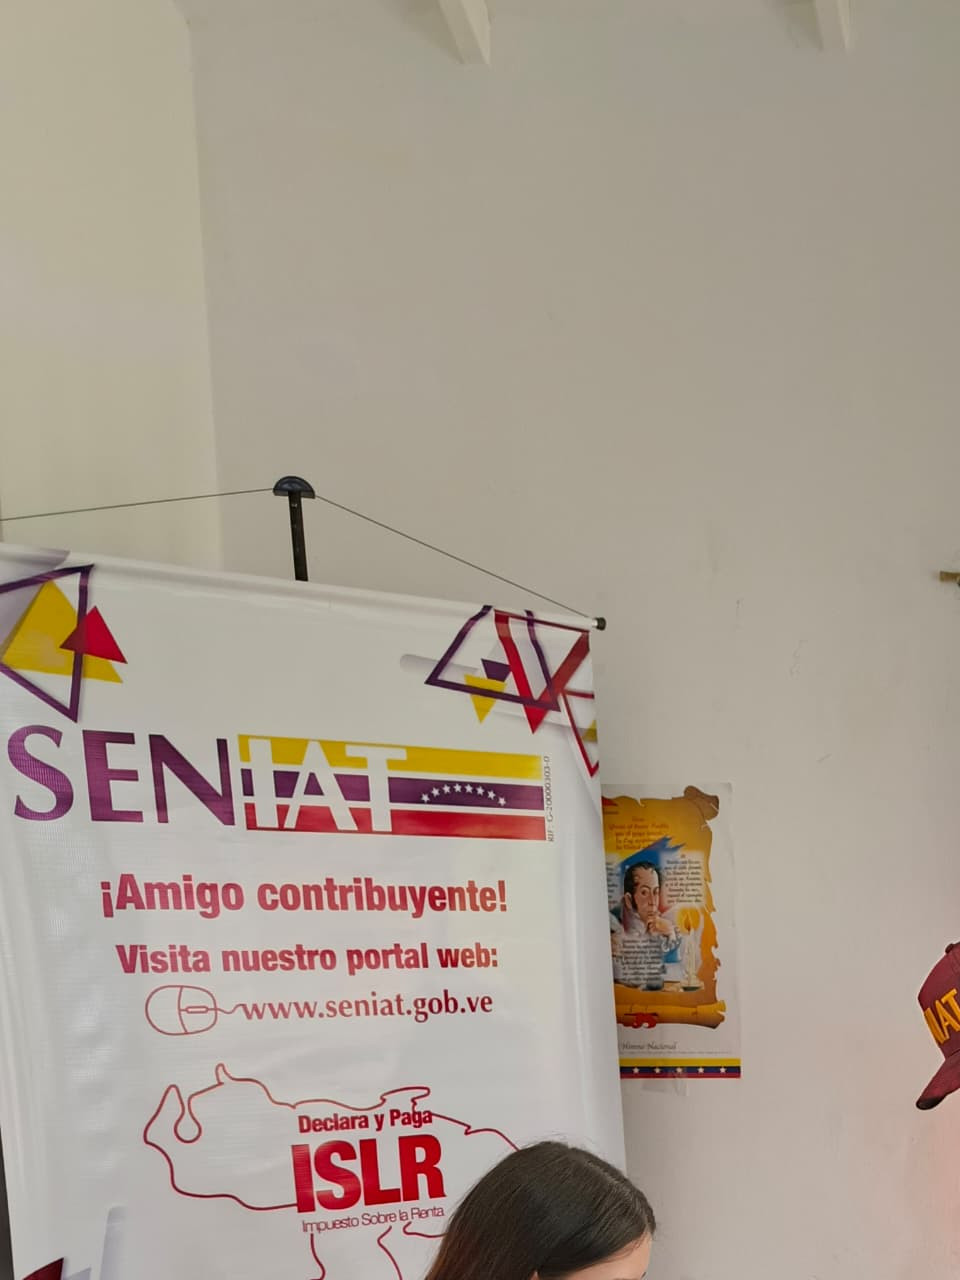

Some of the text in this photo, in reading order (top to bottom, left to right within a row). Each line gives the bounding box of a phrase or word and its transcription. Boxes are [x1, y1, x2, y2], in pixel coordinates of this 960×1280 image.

[7, 724, 408, 832] SENIAT
[101, 873, 507, 918] ¡Amigo contribuyente!
[116, 942, 499, 976] Visita nuestro portal web:
[241, 990, 493, 1023] www.seniat.gob.ve
[298, 1109, 433, 1133] Declara y Paga
[291, 1134, 447, 1213] ISLR
[302, 1206, 445, 1233] Impuesto Sobre la Renta
